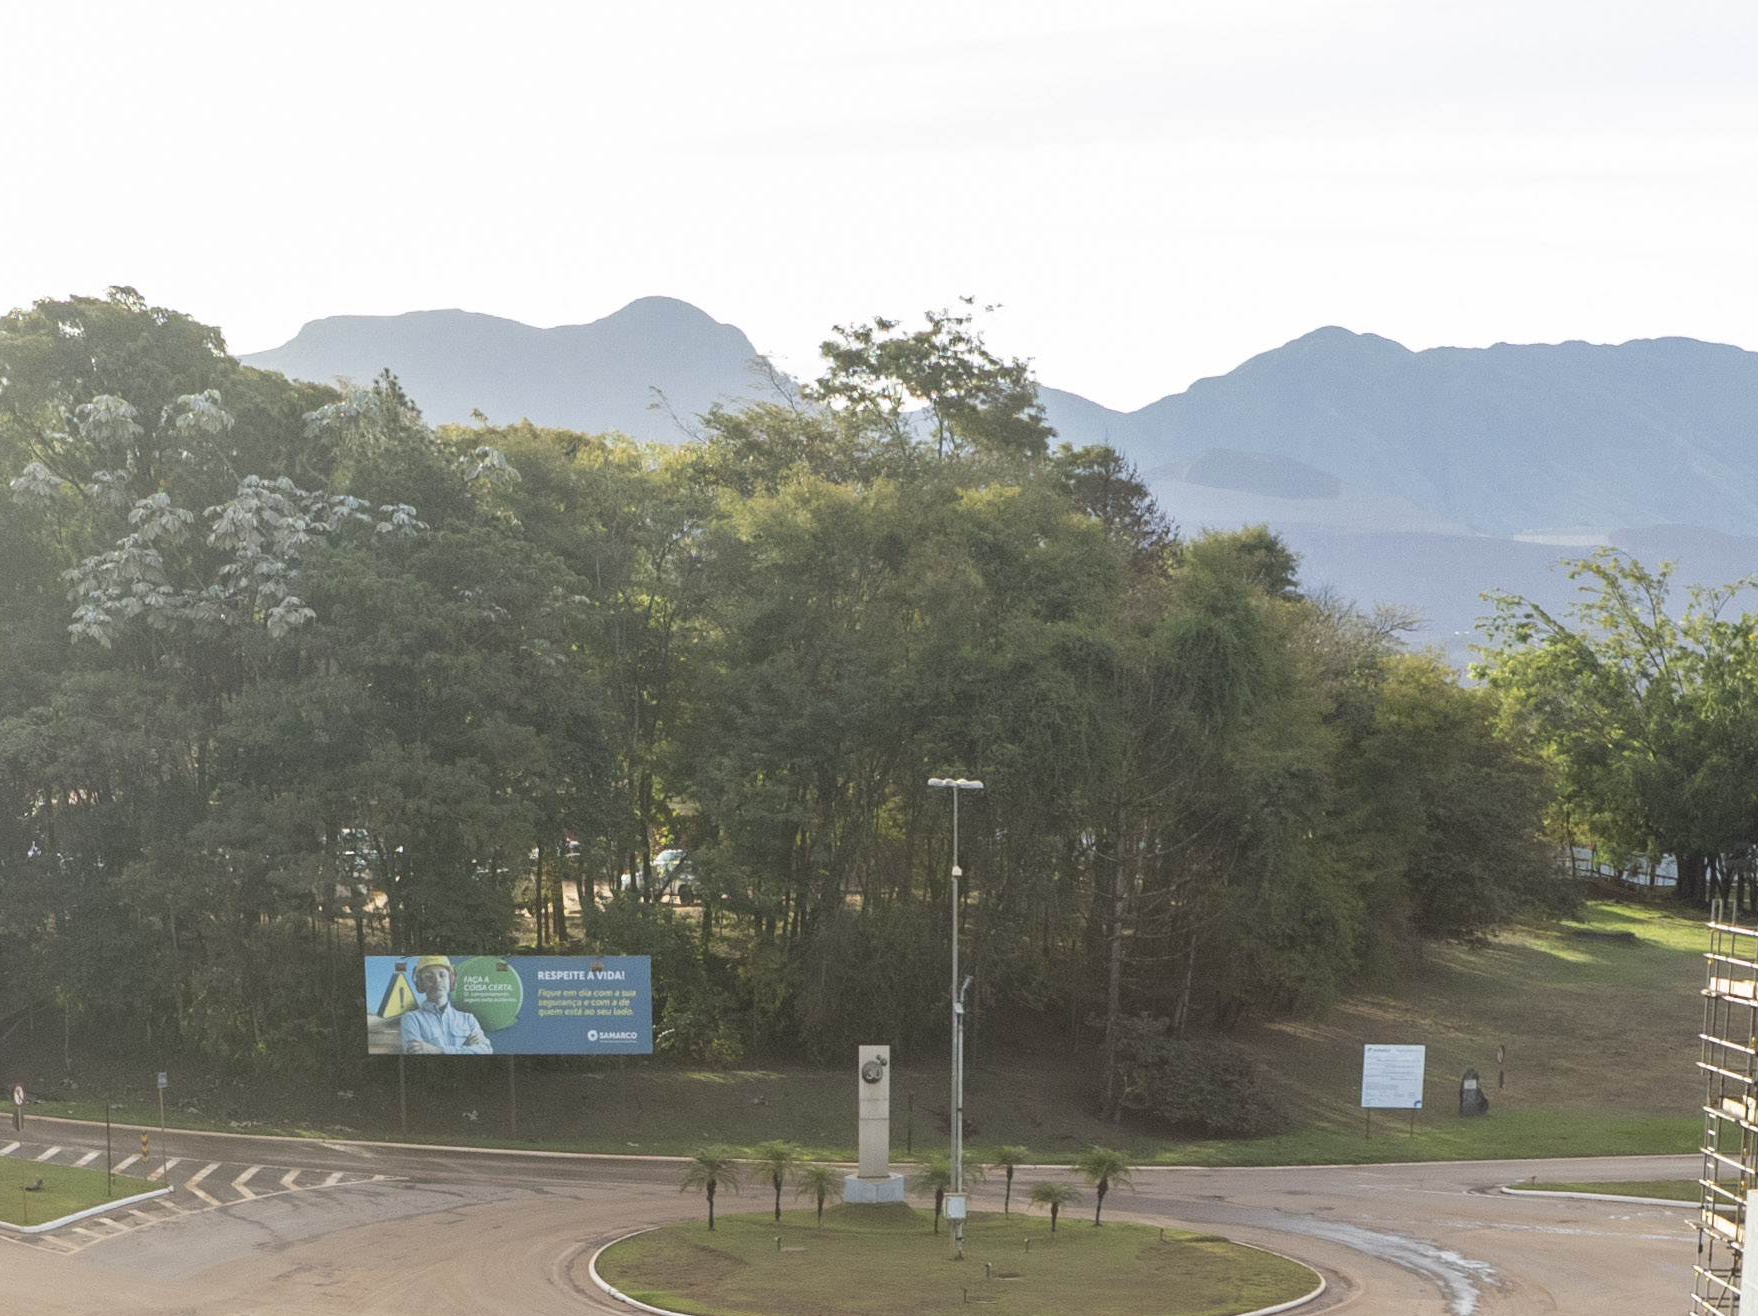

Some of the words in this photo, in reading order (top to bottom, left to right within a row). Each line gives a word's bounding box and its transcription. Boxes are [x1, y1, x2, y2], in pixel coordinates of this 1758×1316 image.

[537, 970, 585, 980] RESPEITE
[587, 970, 595, 980] A
[595, 970, 625, 980] VIDA!
[537, 988, 562, 998] Fique
[578, 988, 592, 997] dia
[619, 998, 631, 1007] de
[599, 1032, 638, 1040] SAMARCO
